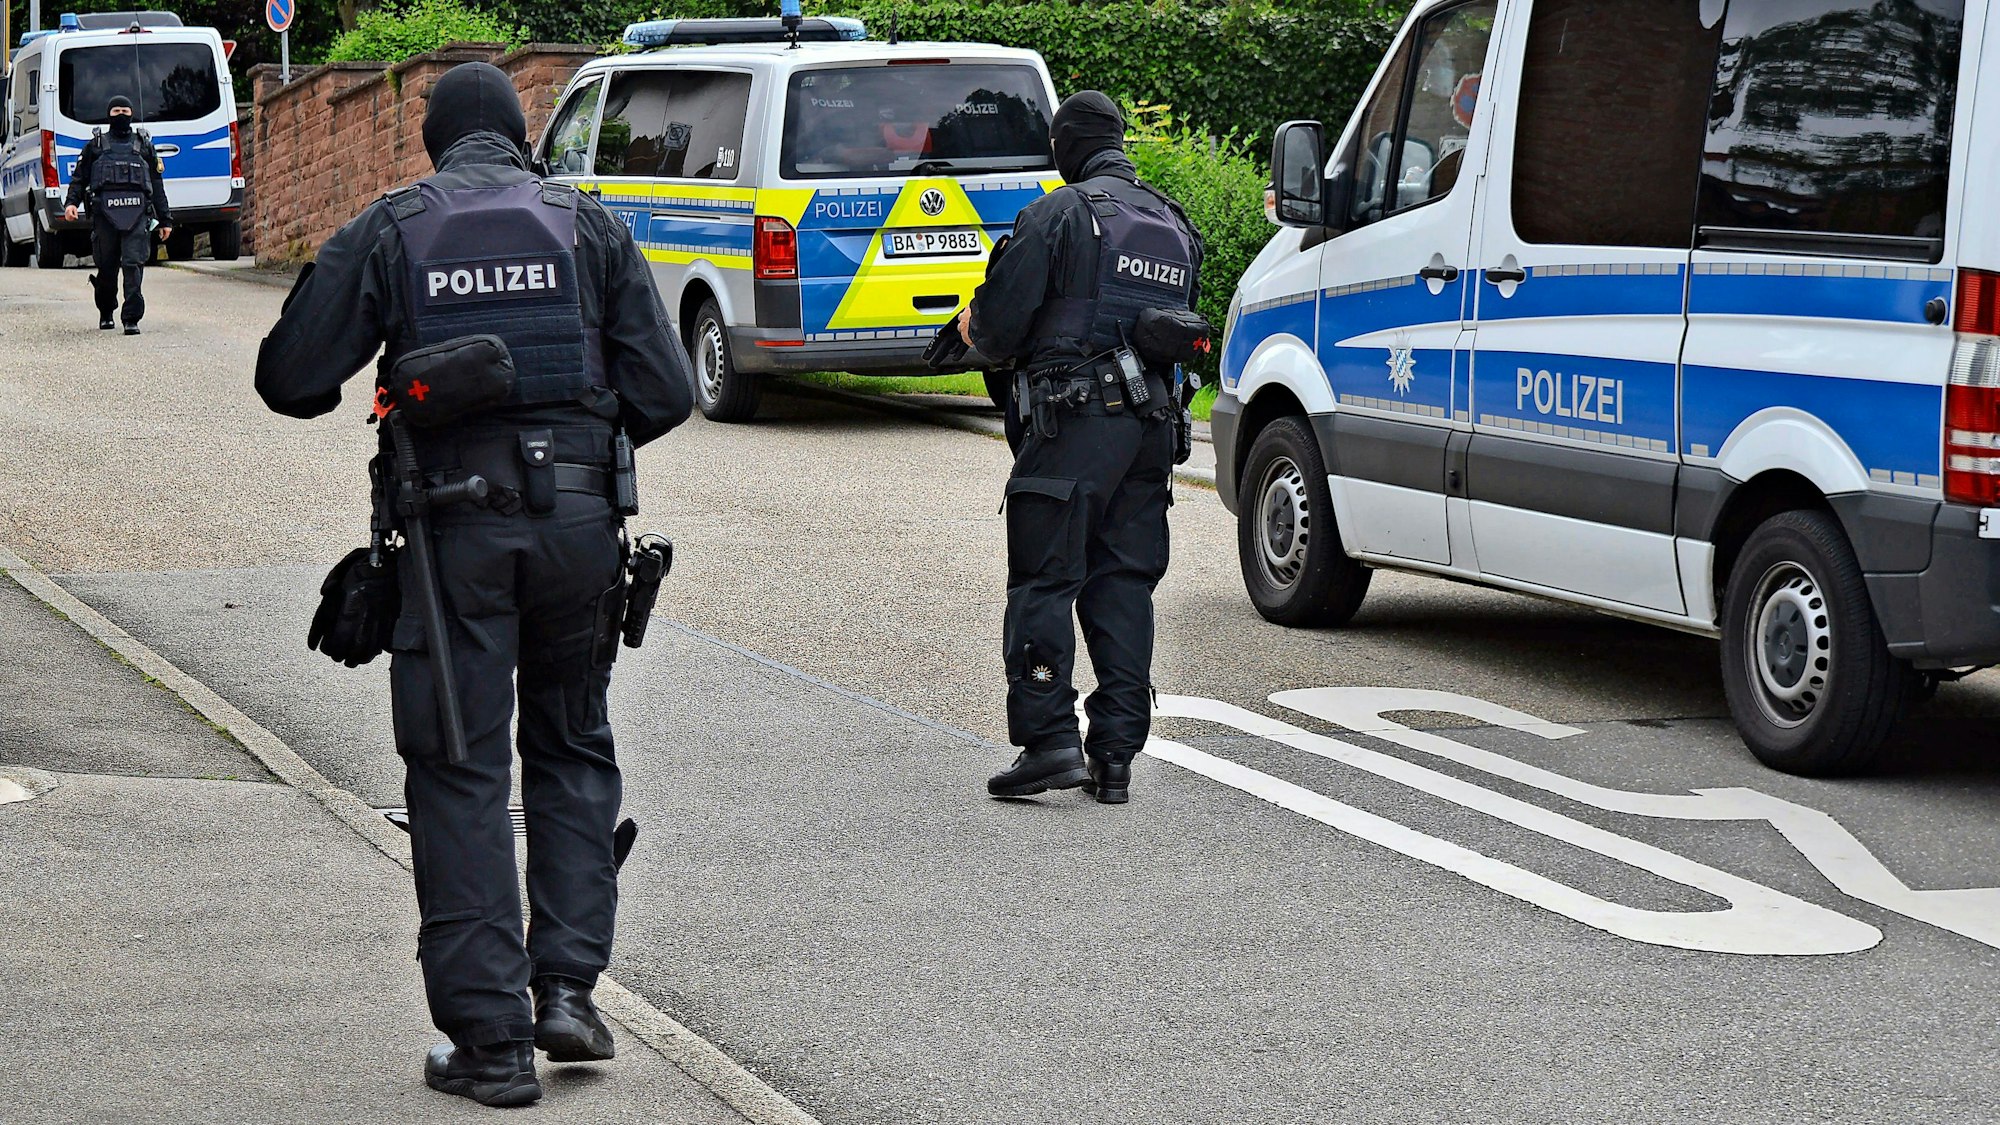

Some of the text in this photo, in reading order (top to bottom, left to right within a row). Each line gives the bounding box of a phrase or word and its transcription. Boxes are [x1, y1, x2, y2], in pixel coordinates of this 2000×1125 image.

[811, 98, 854, 108] POLIZEI
[956, 103, 999, 115] POLIZEI
[723, 149, 735, 167] 110
[108, 198, 140, 207] POLIZEI
[815, 201, 882, 219] POLIZEI
[894, 236, 915, 251] BA
[939, 233, 977, 249] 9883
[1116, 254, 1186, 287] POLIZEI
[427, 263, 557, 297] POLIZEI
[1516, 367, 1623, 425] POLIZEI
